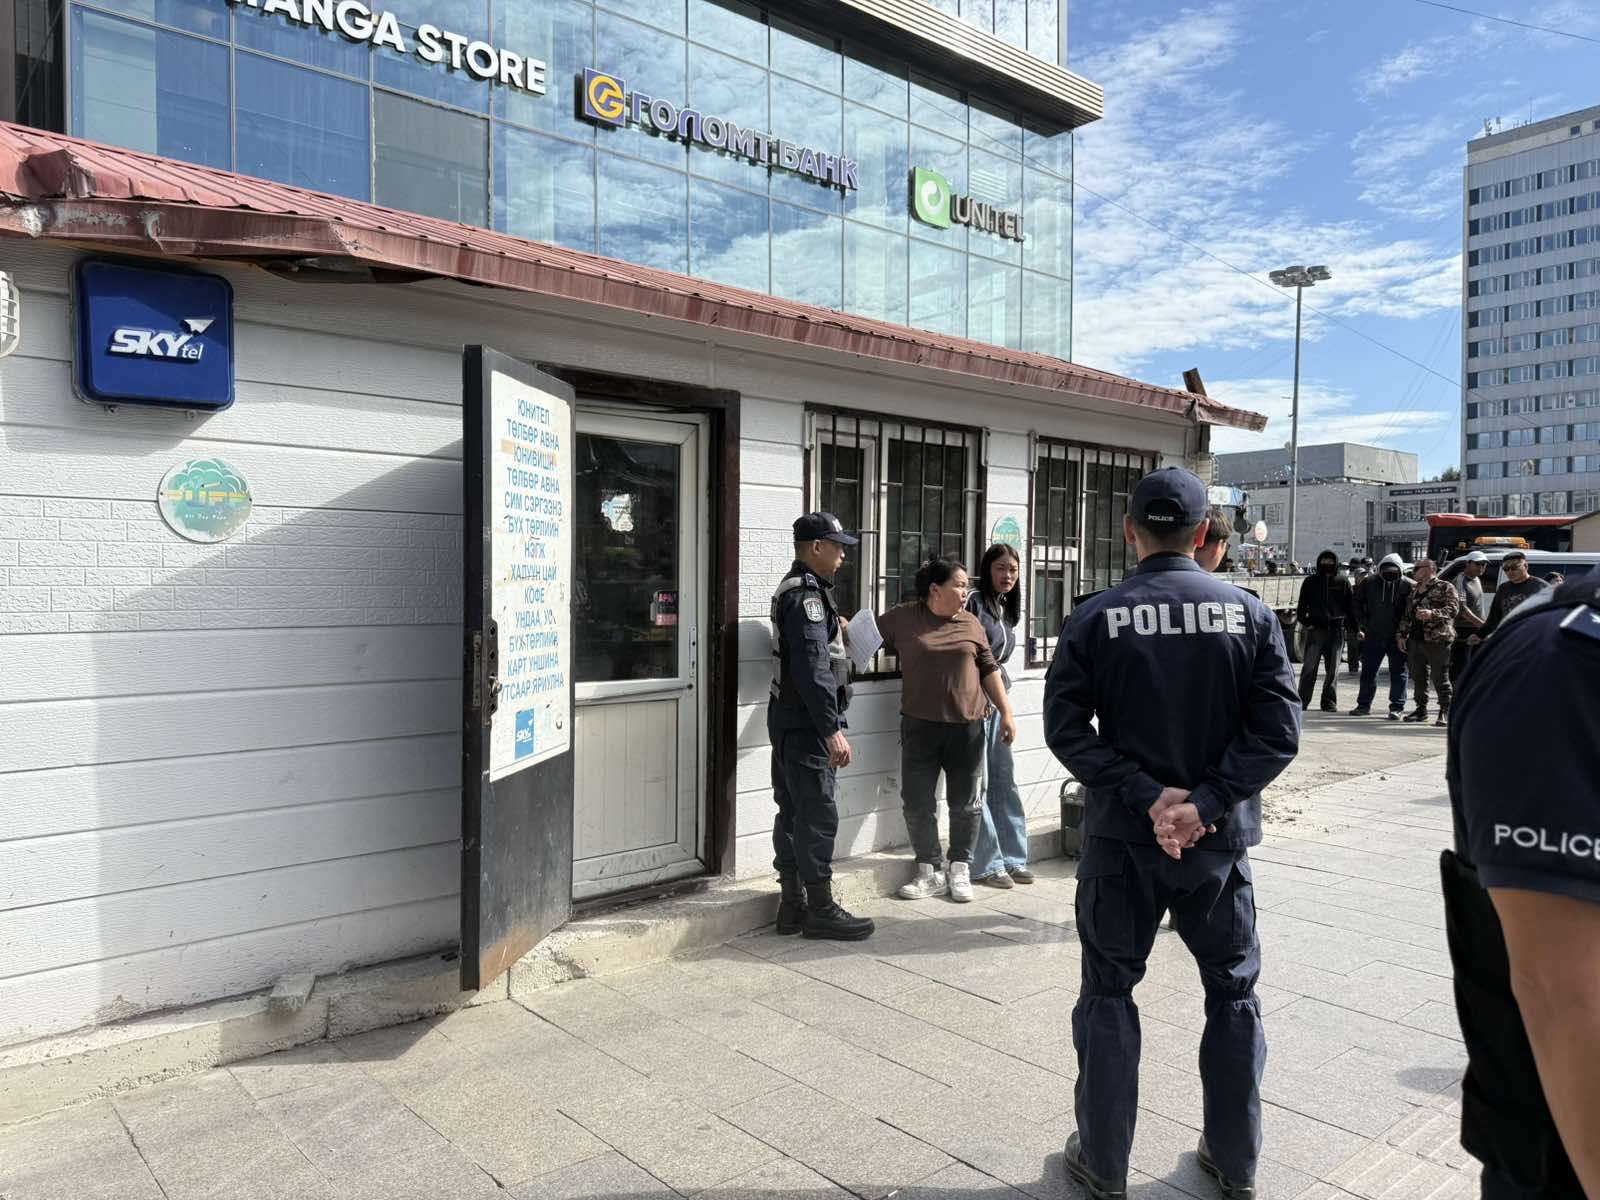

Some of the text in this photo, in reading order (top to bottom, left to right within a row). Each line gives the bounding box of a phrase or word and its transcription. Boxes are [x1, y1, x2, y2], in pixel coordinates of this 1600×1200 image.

[232, 0, 547, 95] ANGA STORE
[631, 92, 859, 190] ГОЛОМТ БАНК
[954, 194, 1025, 242] UNITEL
[517, 399, 549, 426] ЮНИТЕЛ
[506, 418, 560, 452] ТӨЛБӨР АВНА
[507, 467, 560, 494] ТӨЛБӨР АВНА
[504, 491, 522, 510] СИМ
[1147, 514, 1175, 522] POLICE
[524, 541, 546, 559] НЭГЖ
[524, 587, 545, 604] КОФЕ
[1105, 602, 1247, 640] POLICE
[507, 657, 527, 677] КАРТ
